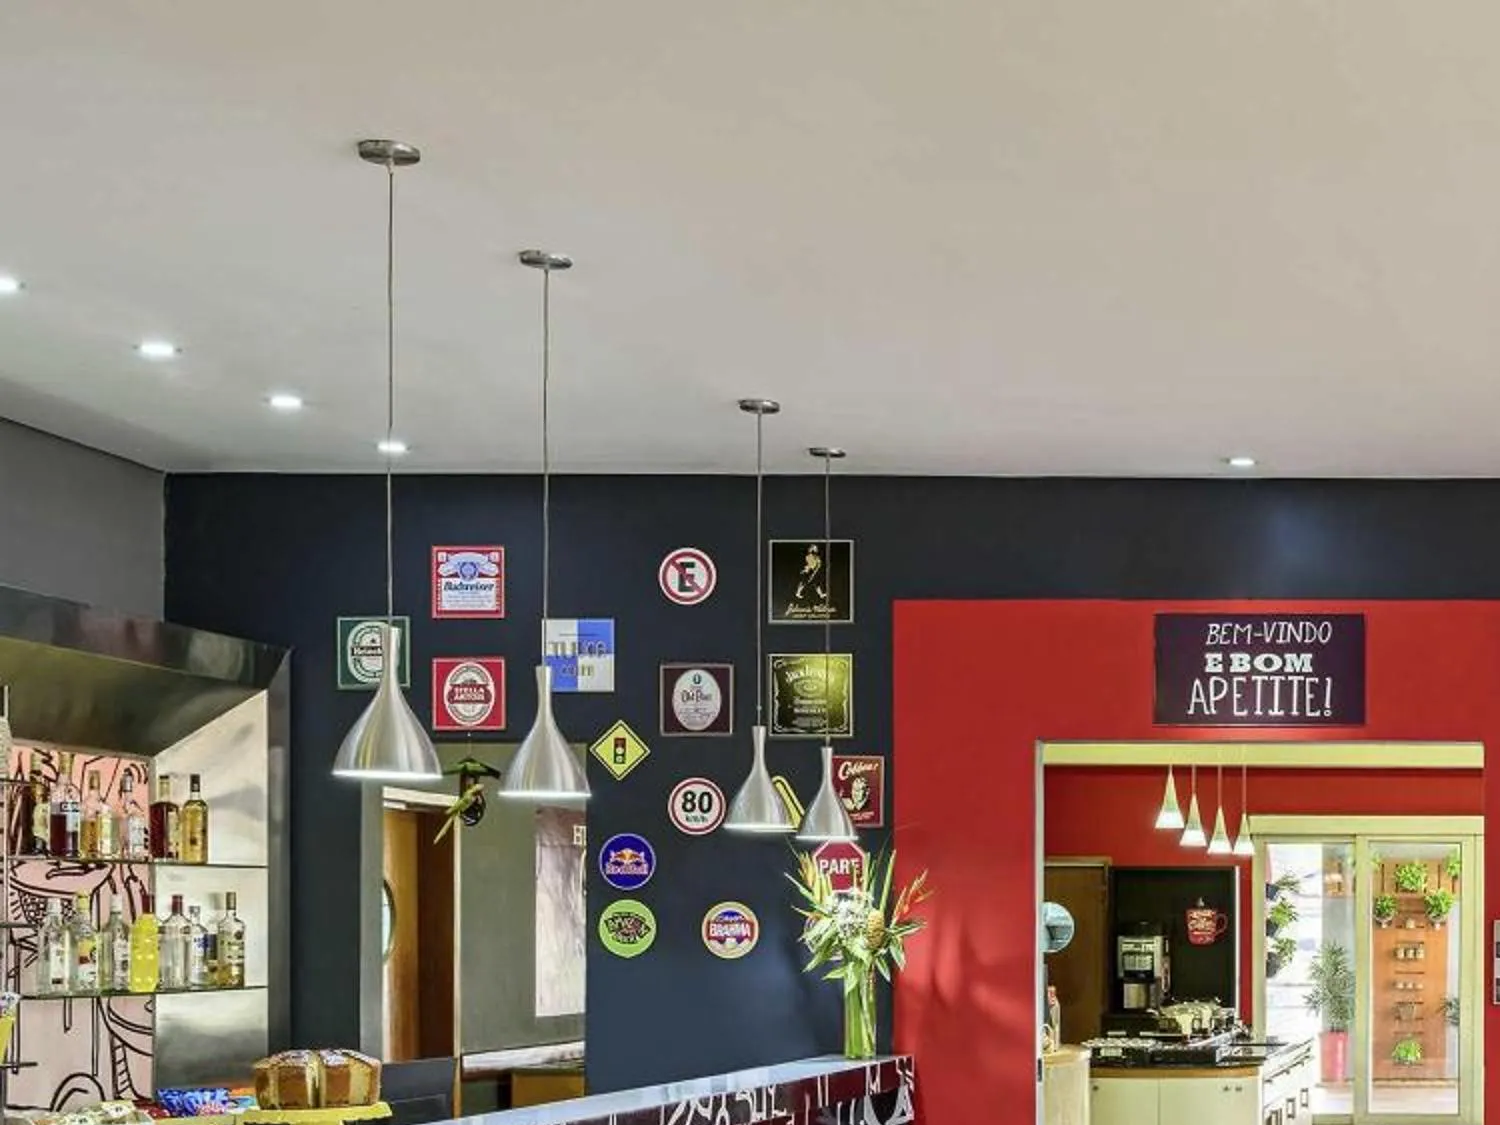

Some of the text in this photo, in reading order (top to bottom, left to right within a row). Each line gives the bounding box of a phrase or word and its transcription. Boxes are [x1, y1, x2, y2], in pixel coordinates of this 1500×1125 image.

[443, 581, 495, 591] Budweiser
[679, 562, 695, 592] E
[1206, 621, 1333, 645] BEM-VINDO
[1205, 653, 1313, 673] E BOM
[1187, 676, 1333, 717] APETITE!
[682, 791, 712, 813] 80
[820, 858, 861, 875] PARE
[709, 922, 751, 937] BRAHMA
